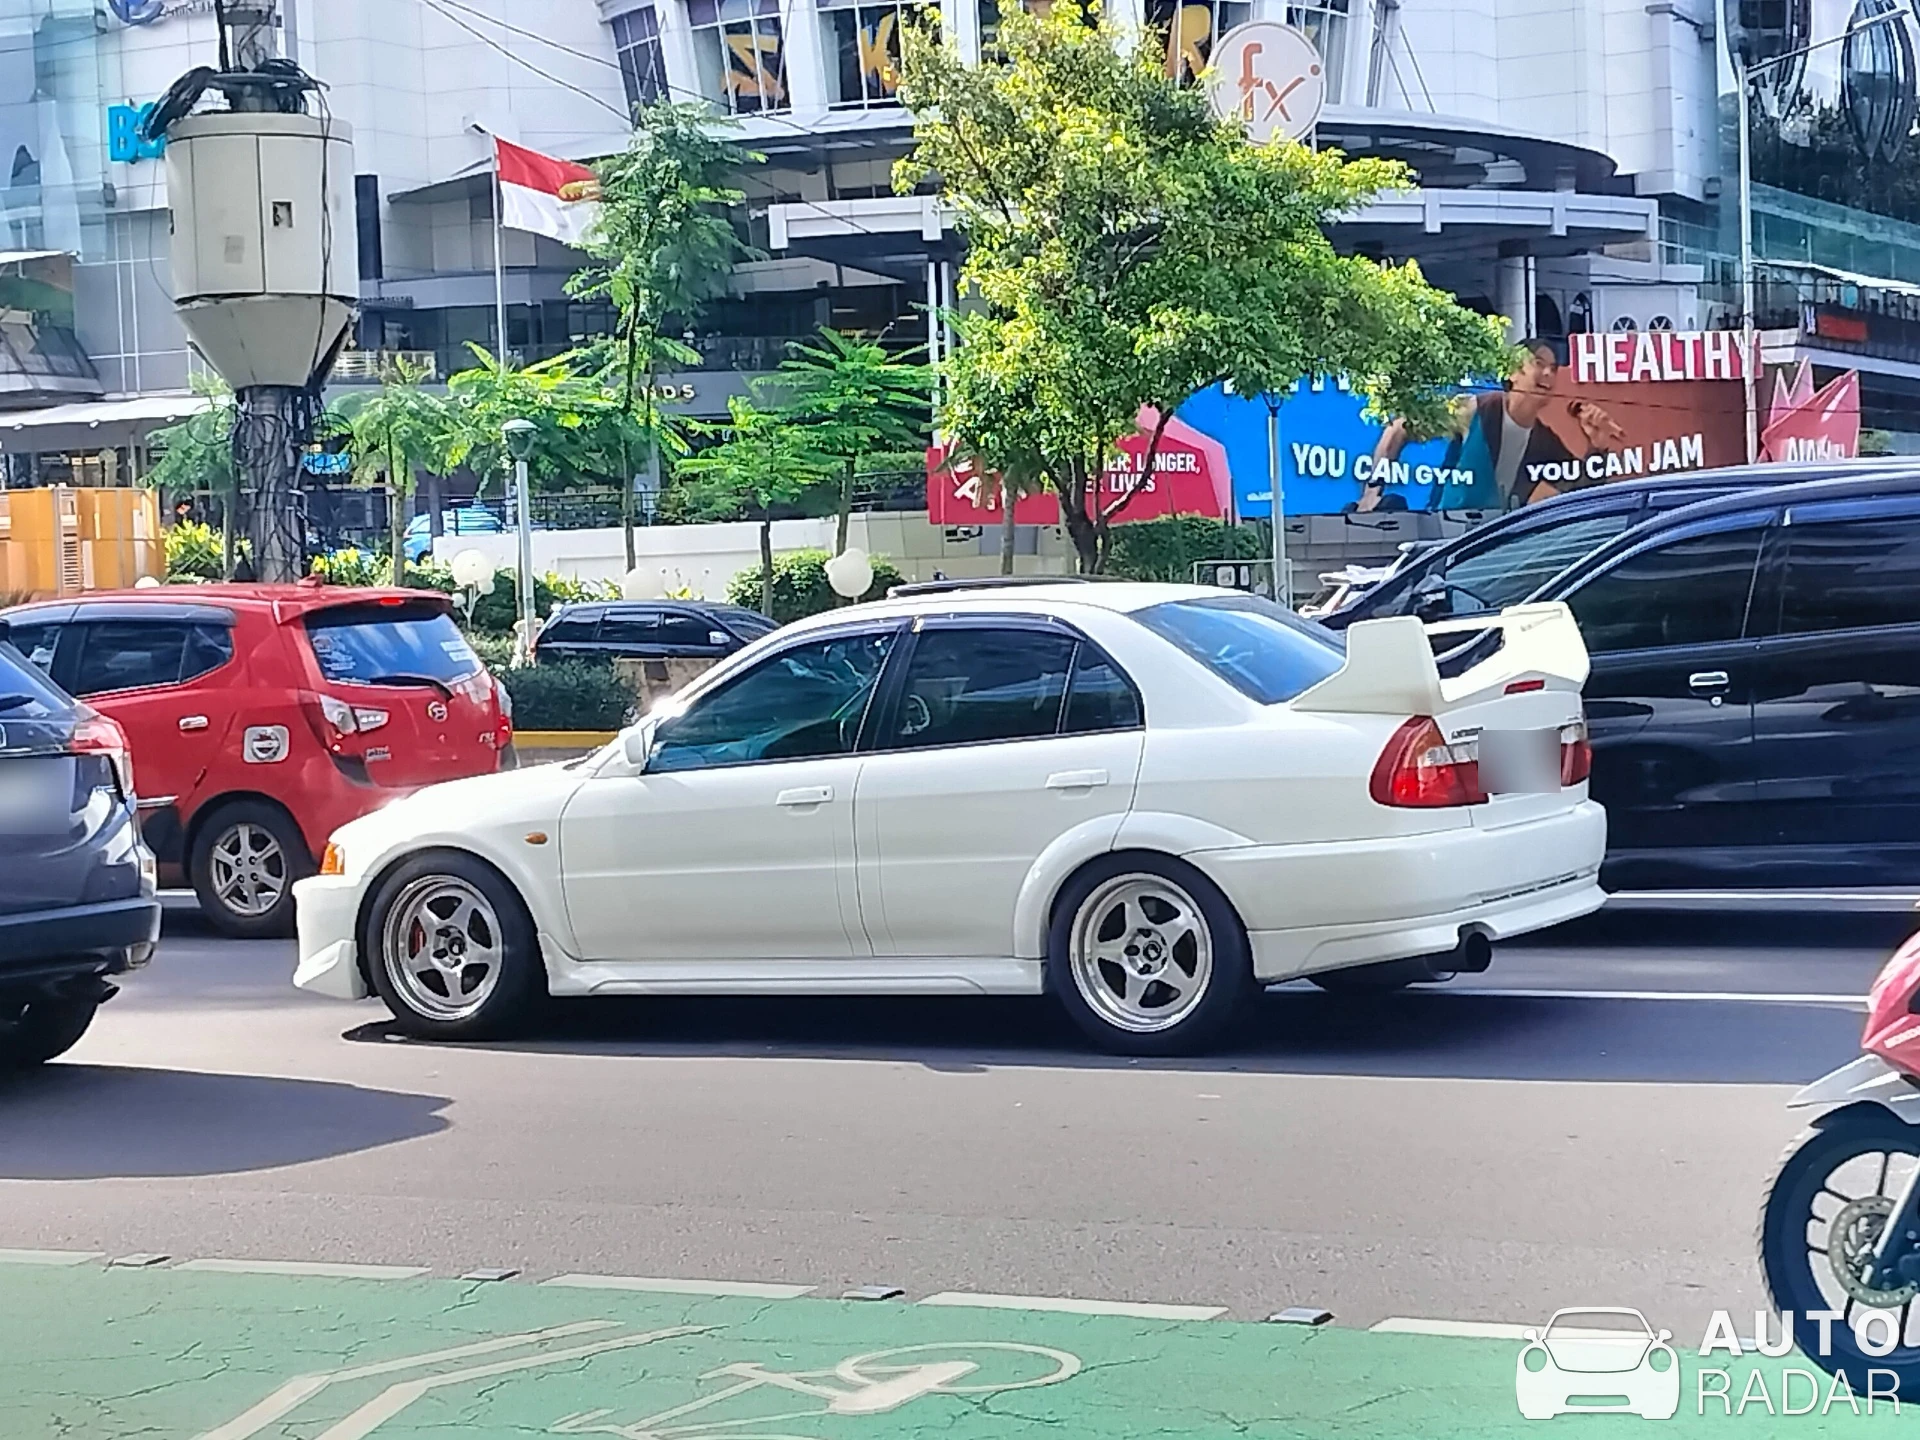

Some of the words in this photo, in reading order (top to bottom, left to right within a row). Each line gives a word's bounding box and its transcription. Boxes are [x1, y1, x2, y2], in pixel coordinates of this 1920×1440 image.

[1577, 330, 1761, 382] HEALTHY
[1136, 452, 1201, 474] LNGER,
[1292, 442, 1346, 478] YOU
[1354, 455, 1410, 485] CAN
[1415, 464, 1473, 485] GYM
[1526, 460, 1580, 482] YOU
[1586, 447, 1643, 479] CAN
[1649, 433, 1704, 472] JAM
